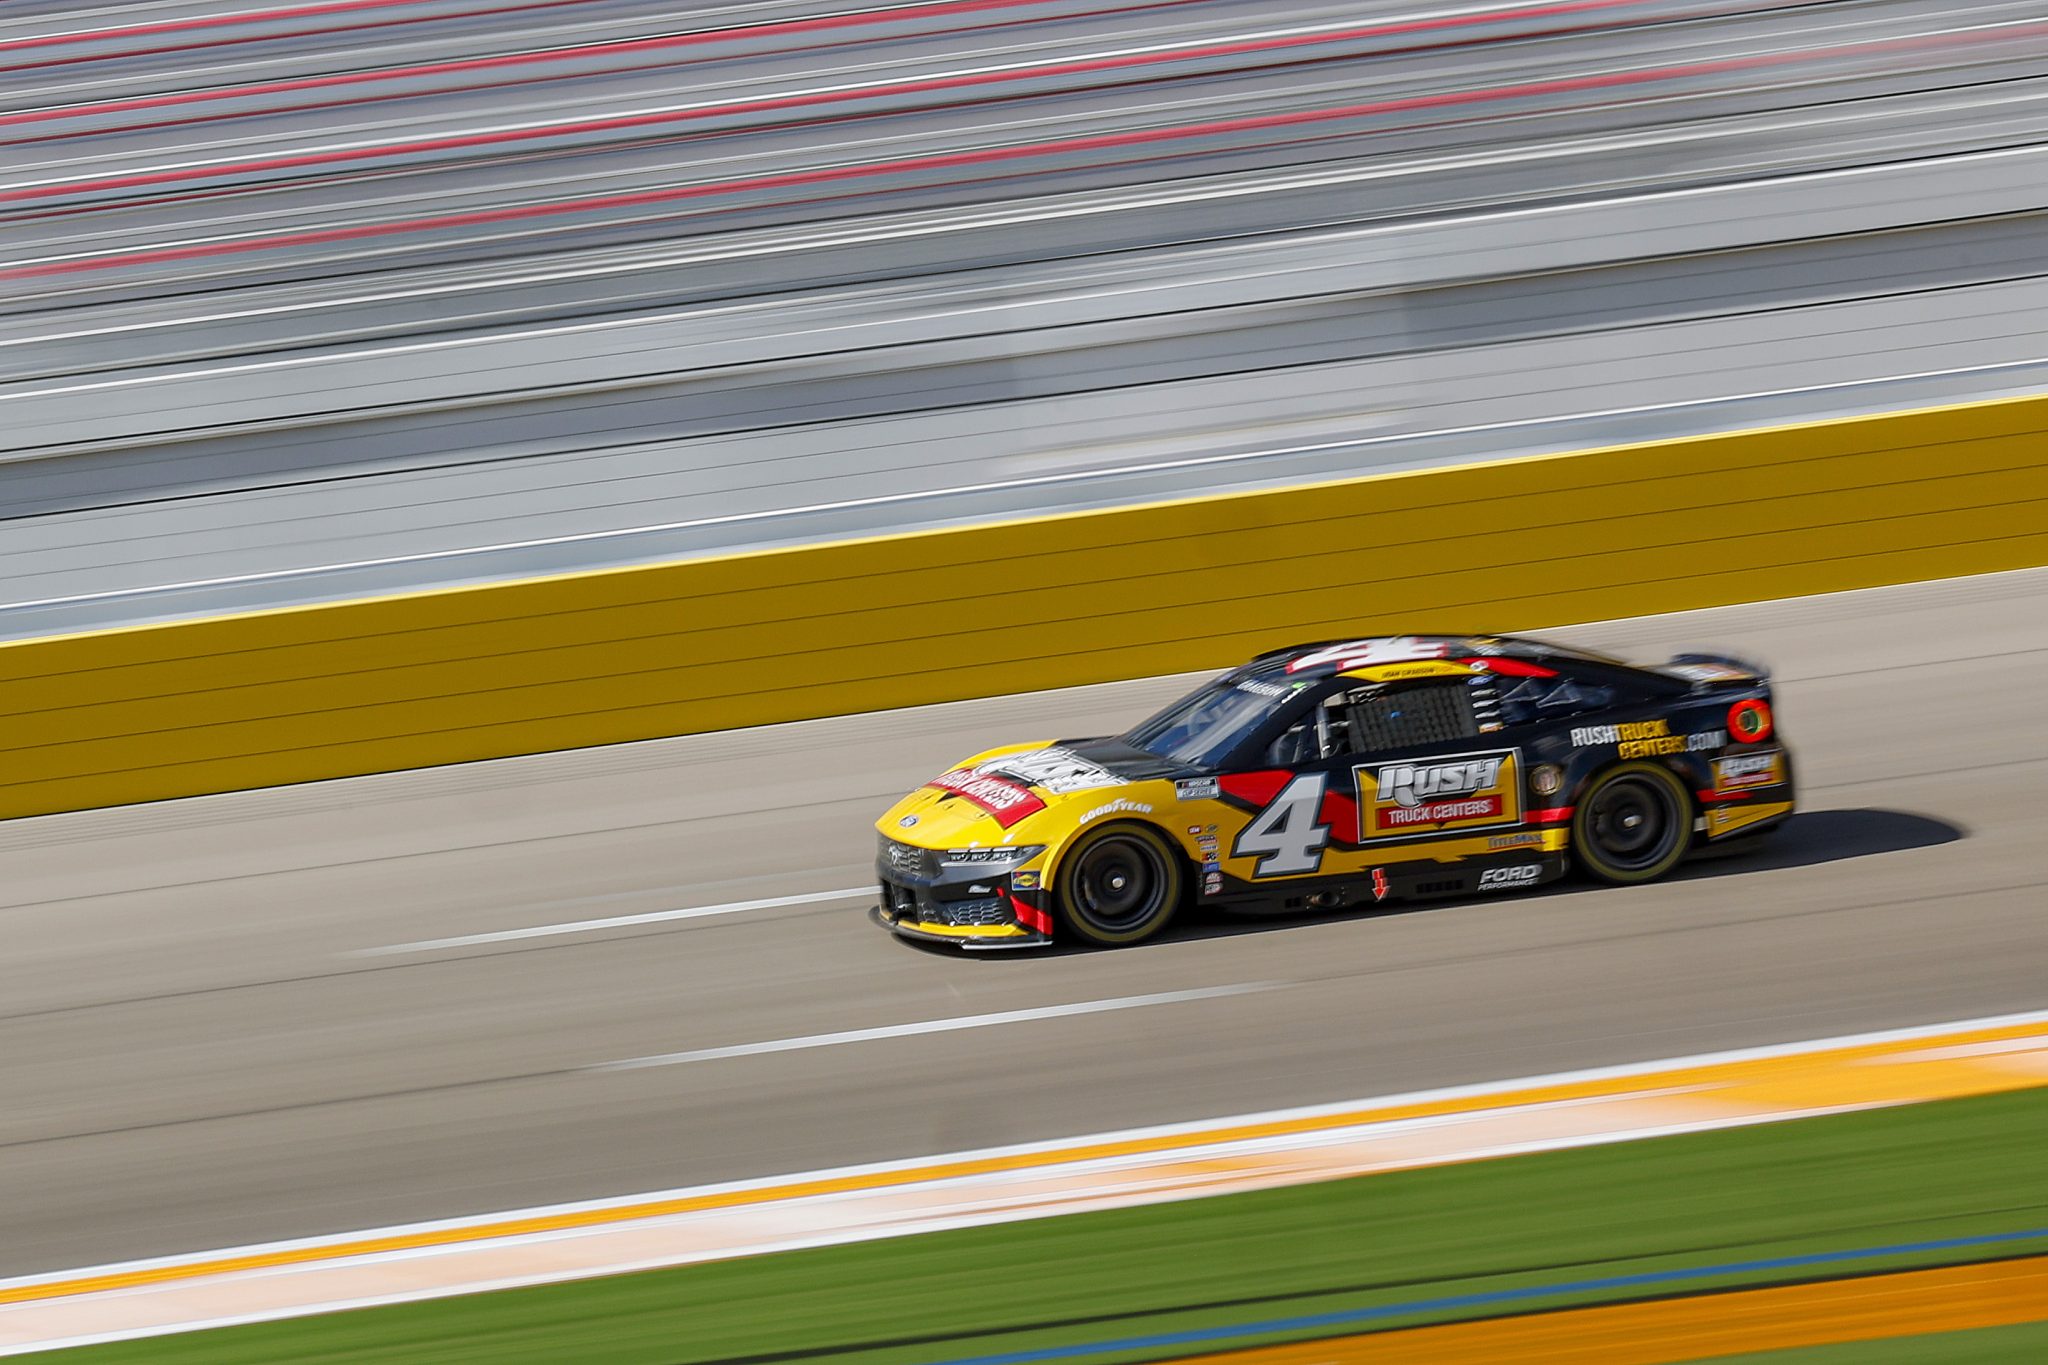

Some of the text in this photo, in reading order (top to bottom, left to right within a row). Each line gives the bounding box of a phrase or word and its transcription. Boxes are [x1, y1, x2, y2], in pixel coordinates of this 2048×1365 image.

[1375, 757, 1505, 808] RUSH
[1080, 798, 1153, 824] GOODYEAR
[1388, 799, 1494, 824] TRUCK CENTERS
[1229, 770, 1330, 878] 4
[1477, 877, 1539, 891] PERFORMANCE
[1480, 865, 1543, 883] FORD
